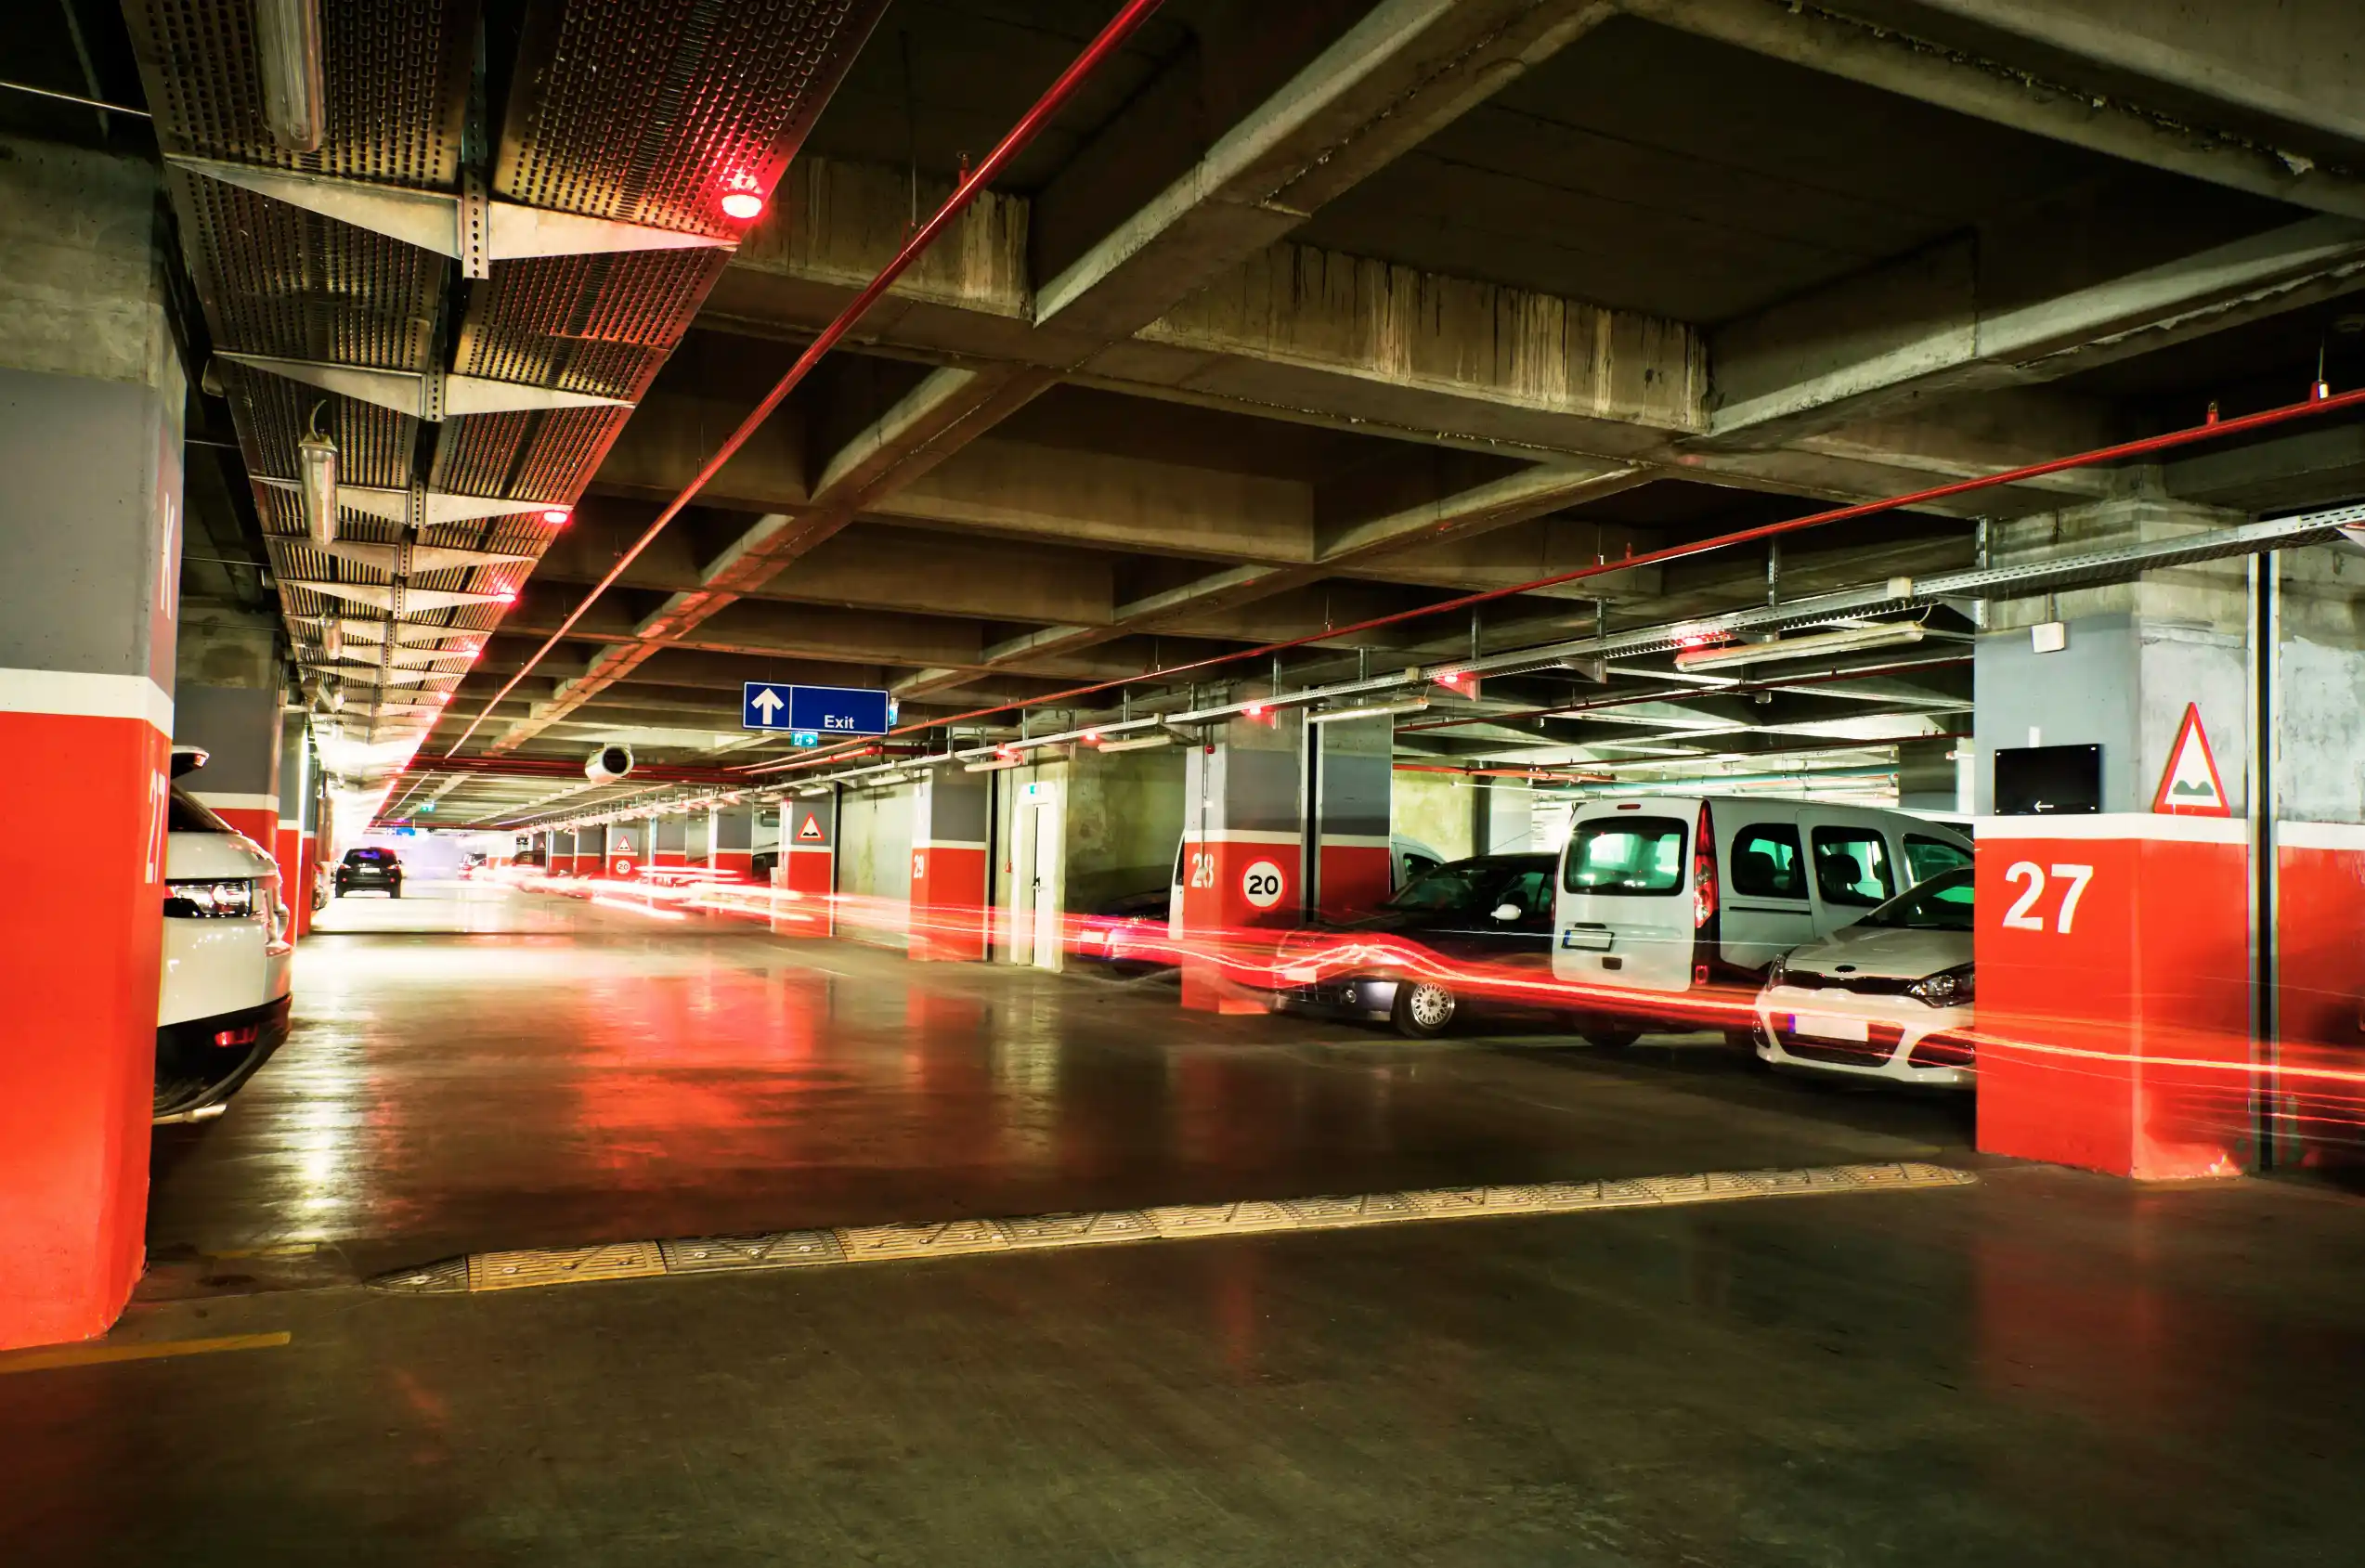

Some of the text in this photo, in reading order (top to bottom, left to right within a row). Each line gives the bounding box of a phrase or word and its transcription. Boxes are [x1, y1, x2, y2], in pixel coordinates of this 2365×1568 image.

[160, 492, 175, 619] K
[824, 714, 854, 730] Exit
[145, 768, 166, 884] 27
[913, 854, 925, 879] 29
[1190, 852, 1215, 888] 28
[1248, 875, 1279, 896] 20
[2002, 861, 2094, 934] 27
